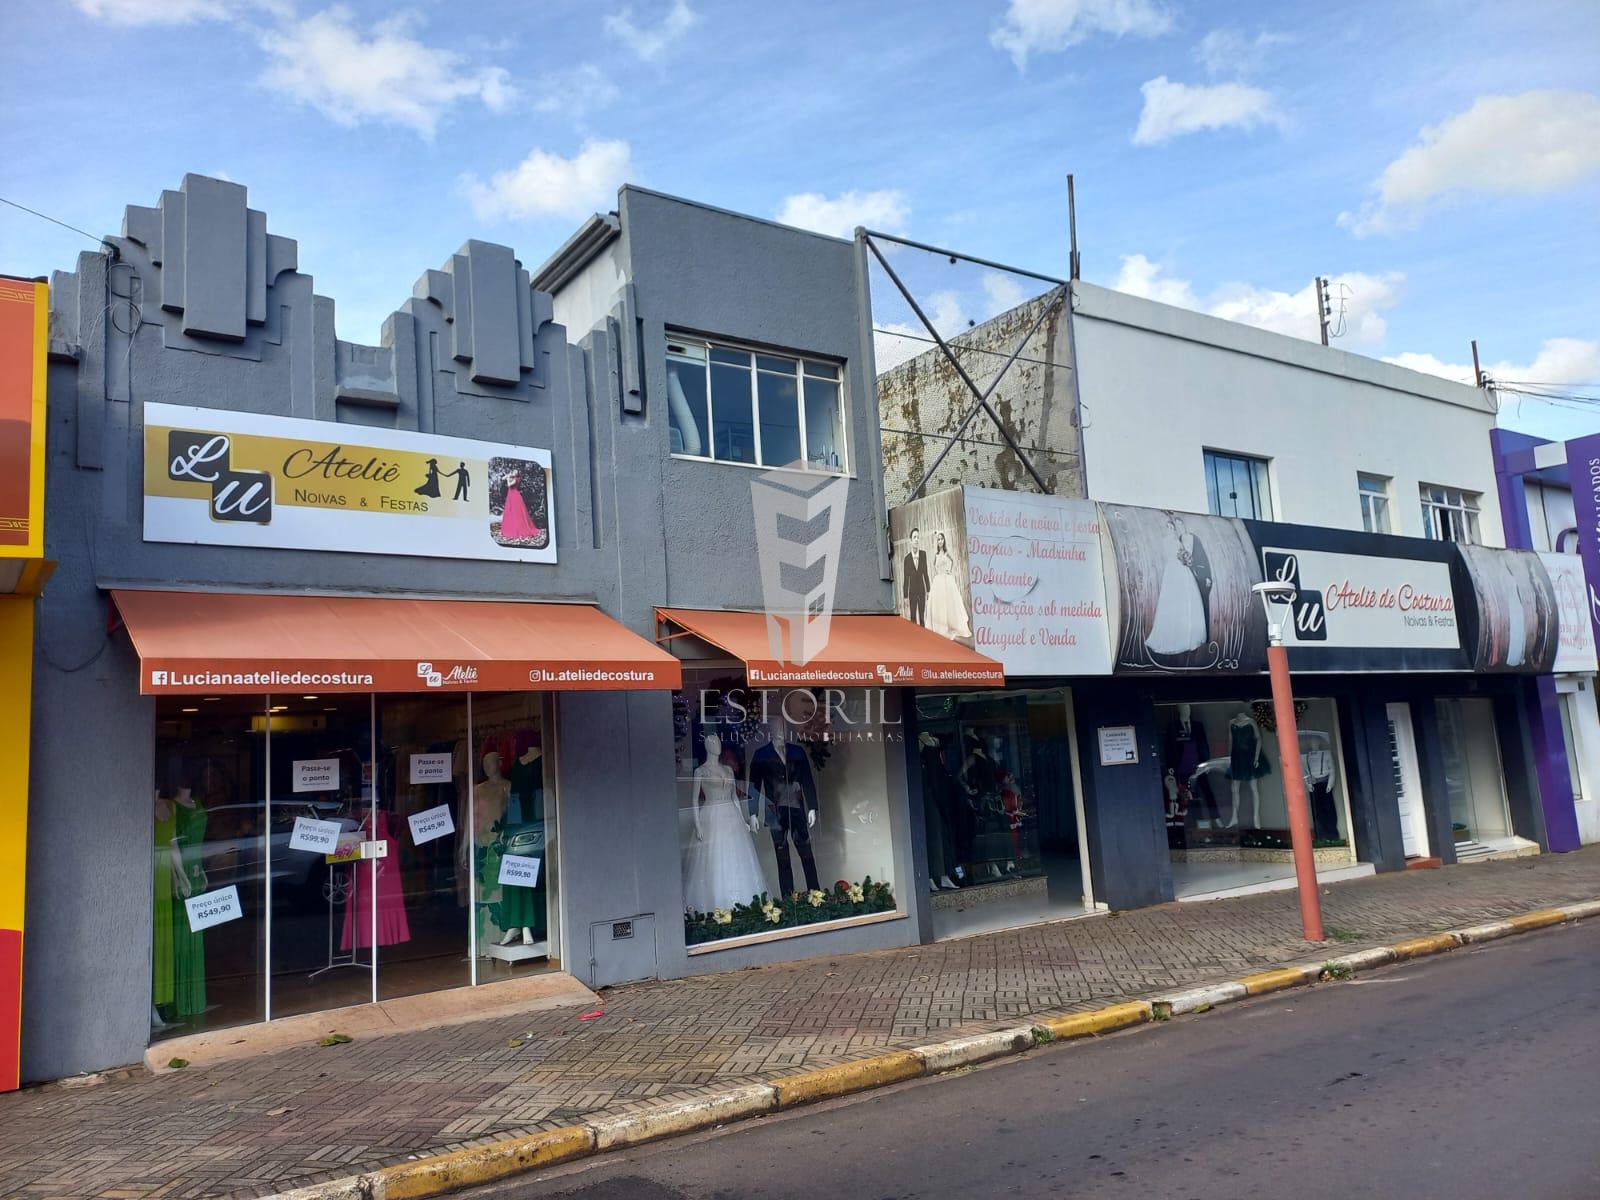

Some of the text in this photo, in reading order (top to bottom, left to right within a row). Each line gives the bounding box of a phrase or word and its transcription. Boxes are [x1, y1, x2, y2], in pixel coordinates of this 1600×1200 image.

[170, 435, 229, 482] L
[282, 446, 401, 483] Ateliê
[295, 488, 429, 513] NOIVAS & FESTAS
[968, 506, 1011, 527] Vestido
[1014, 512, 1028, 529] de
[1030, 515, 1060, 532] noiva
[968, 536, 1013, 557] Damas
[1026, 541, 1087, 561] Madrinha
[971, 566, 1033, 587] Debutante
[1325, 577, 1455, 612] Ateliê de Costura
[973, 596, 1103, 621] Confecção sob medida
[1403, 615, 1427, 628] Noivas
[976, 626, 1078, 651] Aluguel e Venda
[170, 670, 374, 686] Lucianaateliedecostura
[541, 668, 655, 682] lu.ateliedecostura
[760, 669, 875, 682] Lucianaateliedecostura
[929, 668, 1003, 680] lu.ateliedecostura
[191, 900, 212, 910] Preço
[197, 904, 231, 919] R$49,90
